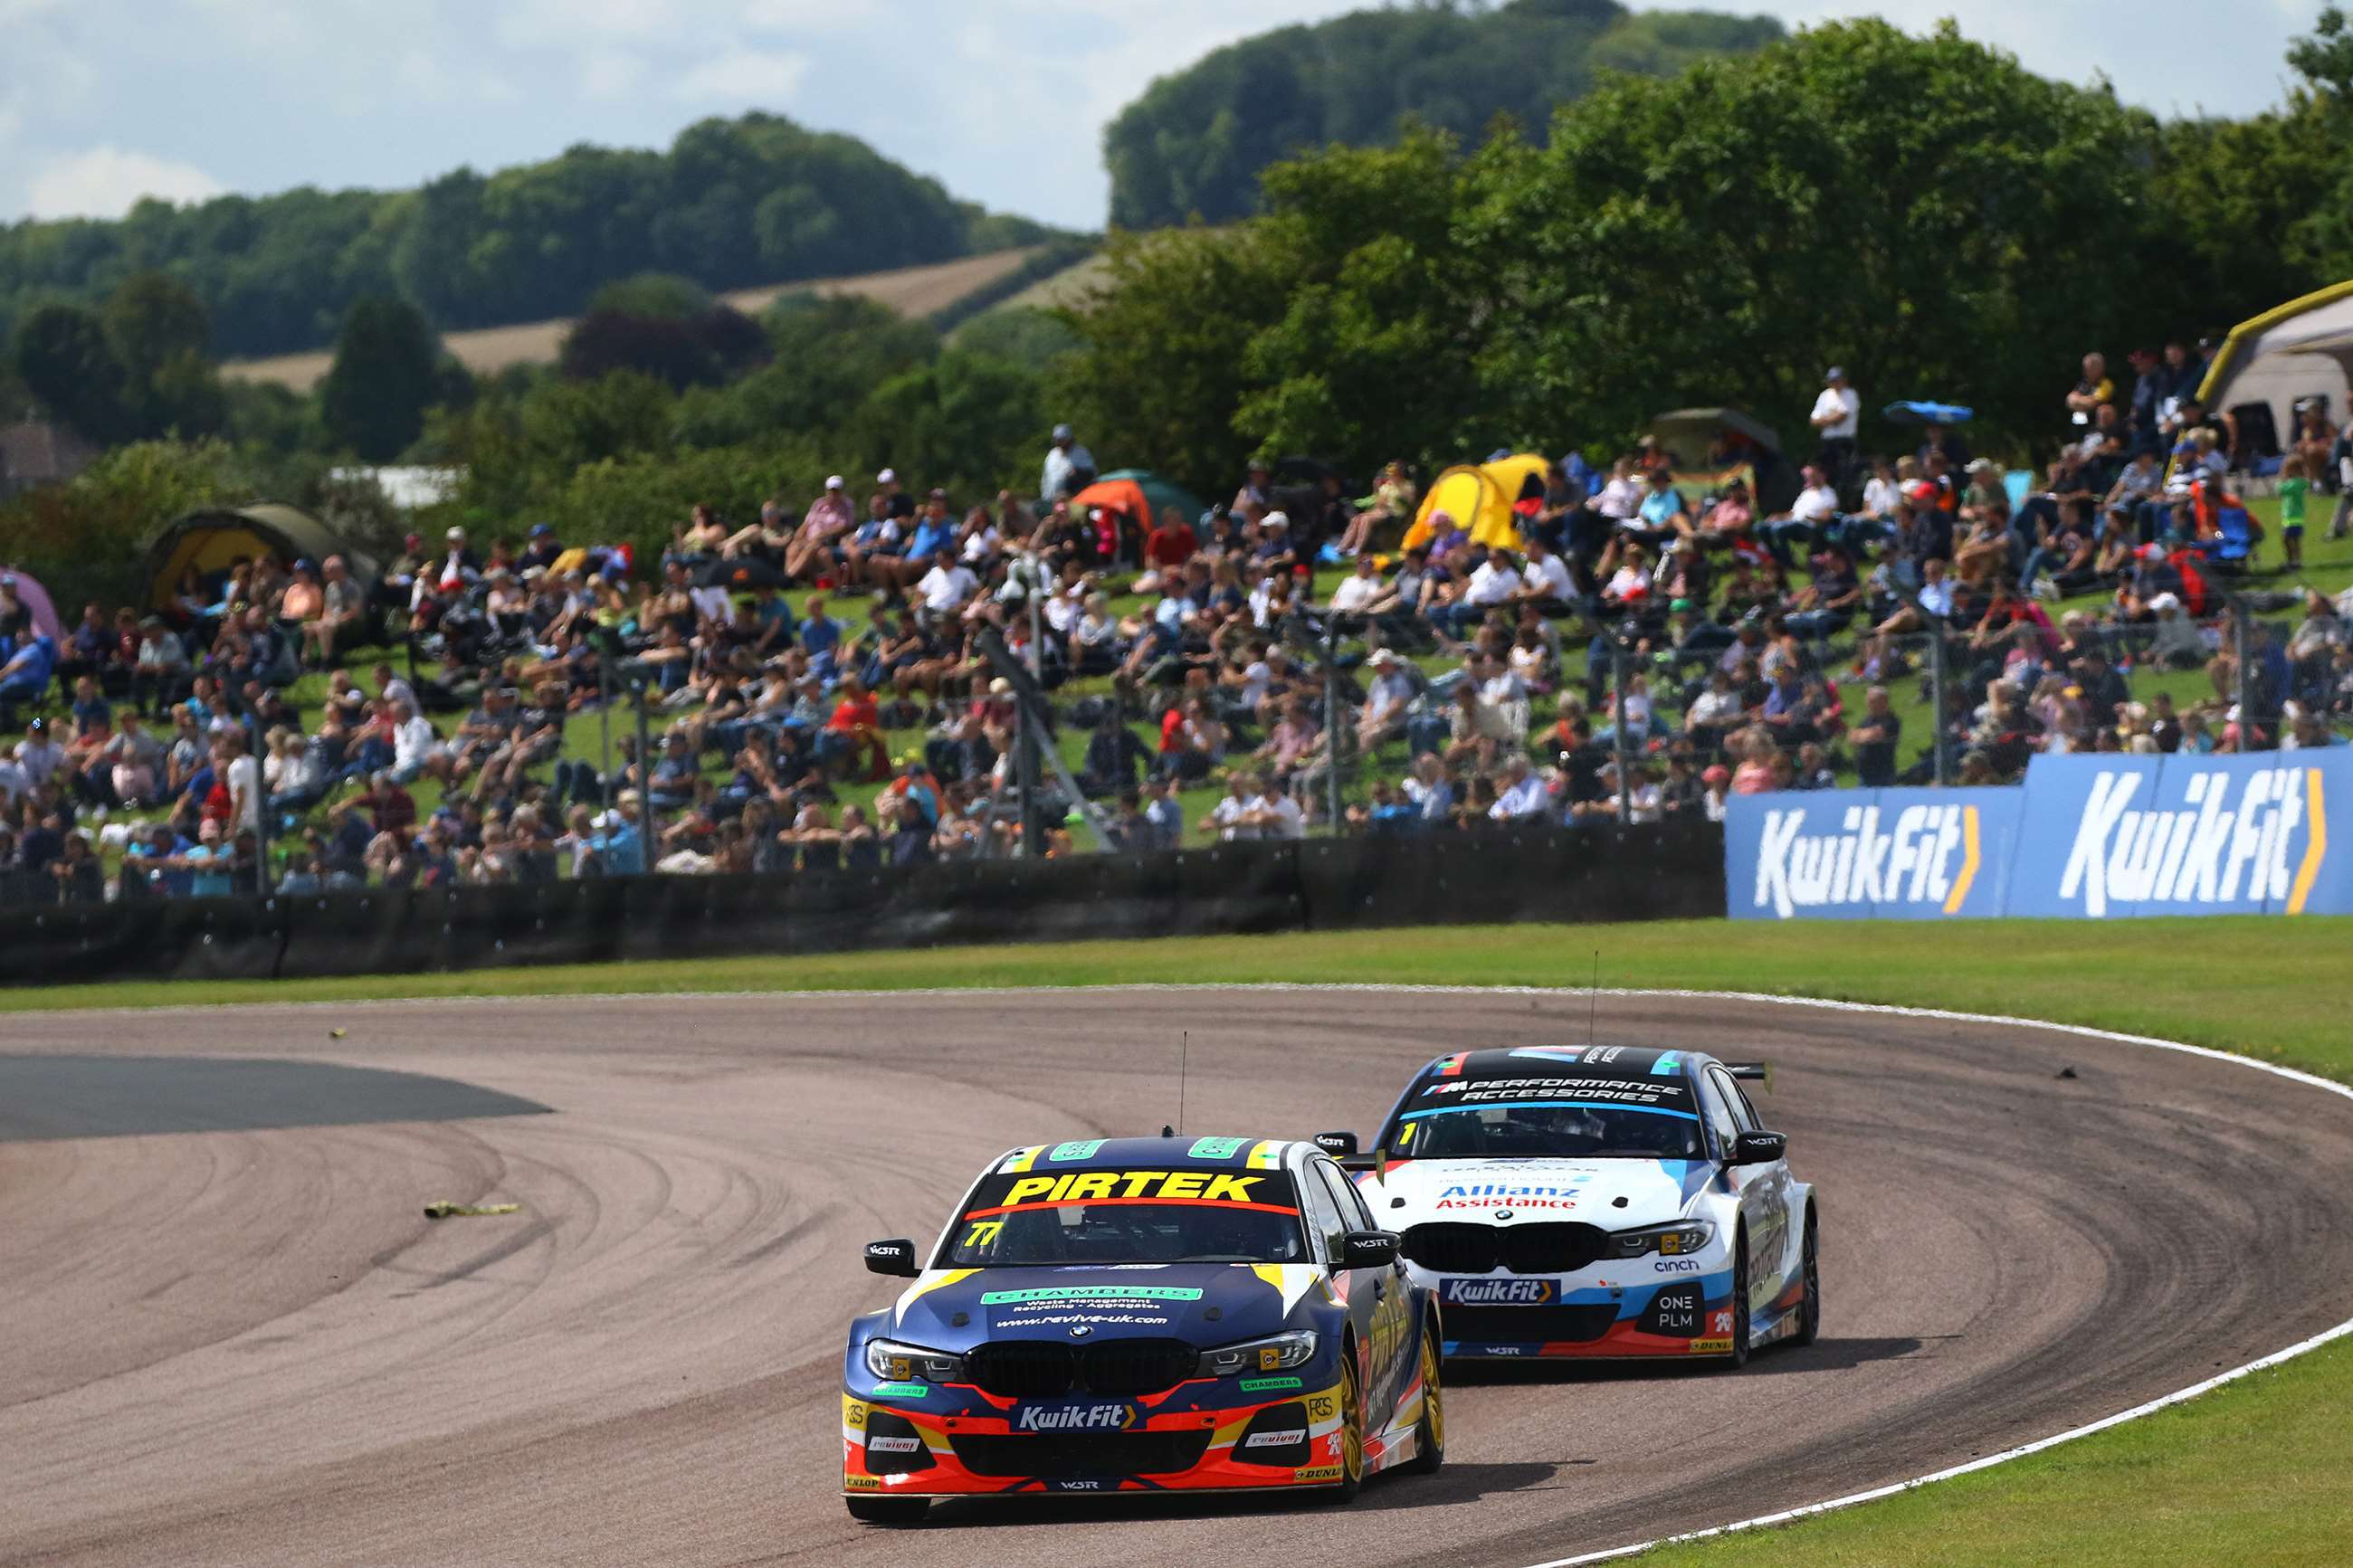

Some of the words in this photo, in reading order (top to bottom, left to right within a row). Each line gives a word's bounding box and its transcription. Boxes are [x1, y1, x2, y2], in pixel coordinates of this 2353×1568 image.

[1468, 1078, 1683, 1096] PERFORMANCE
[1460, 1088, 1660, 1103] ACCESSORIES
[1399, 1121, 1417, 1145] 1
[1000, 1171, 1266, 1207] PIRTEK
[1439, 1184, 1581, 1198] Allianz
[1435, 1197, 1577, 1210] Assistance
[964, 1221, 1004, 1247] 77
[869, 1245, 900, 1255] WSR
[1354, 1239, 1389, 1248] WSR
[1654, 1259, 1700, 1273] cinch
[995, 1288, 1189, 1300] CHAMBERS
[1660, 1297, 1693, 1309] ONE
[996, 1314, 1168, 1328] www.revive-uk.com
[1659, 1313, 1692, 1327] PLM
[1243, 1379, 1299, 1389] CHAMBERS
[1060, 1481, 1100, 1489] WSR
